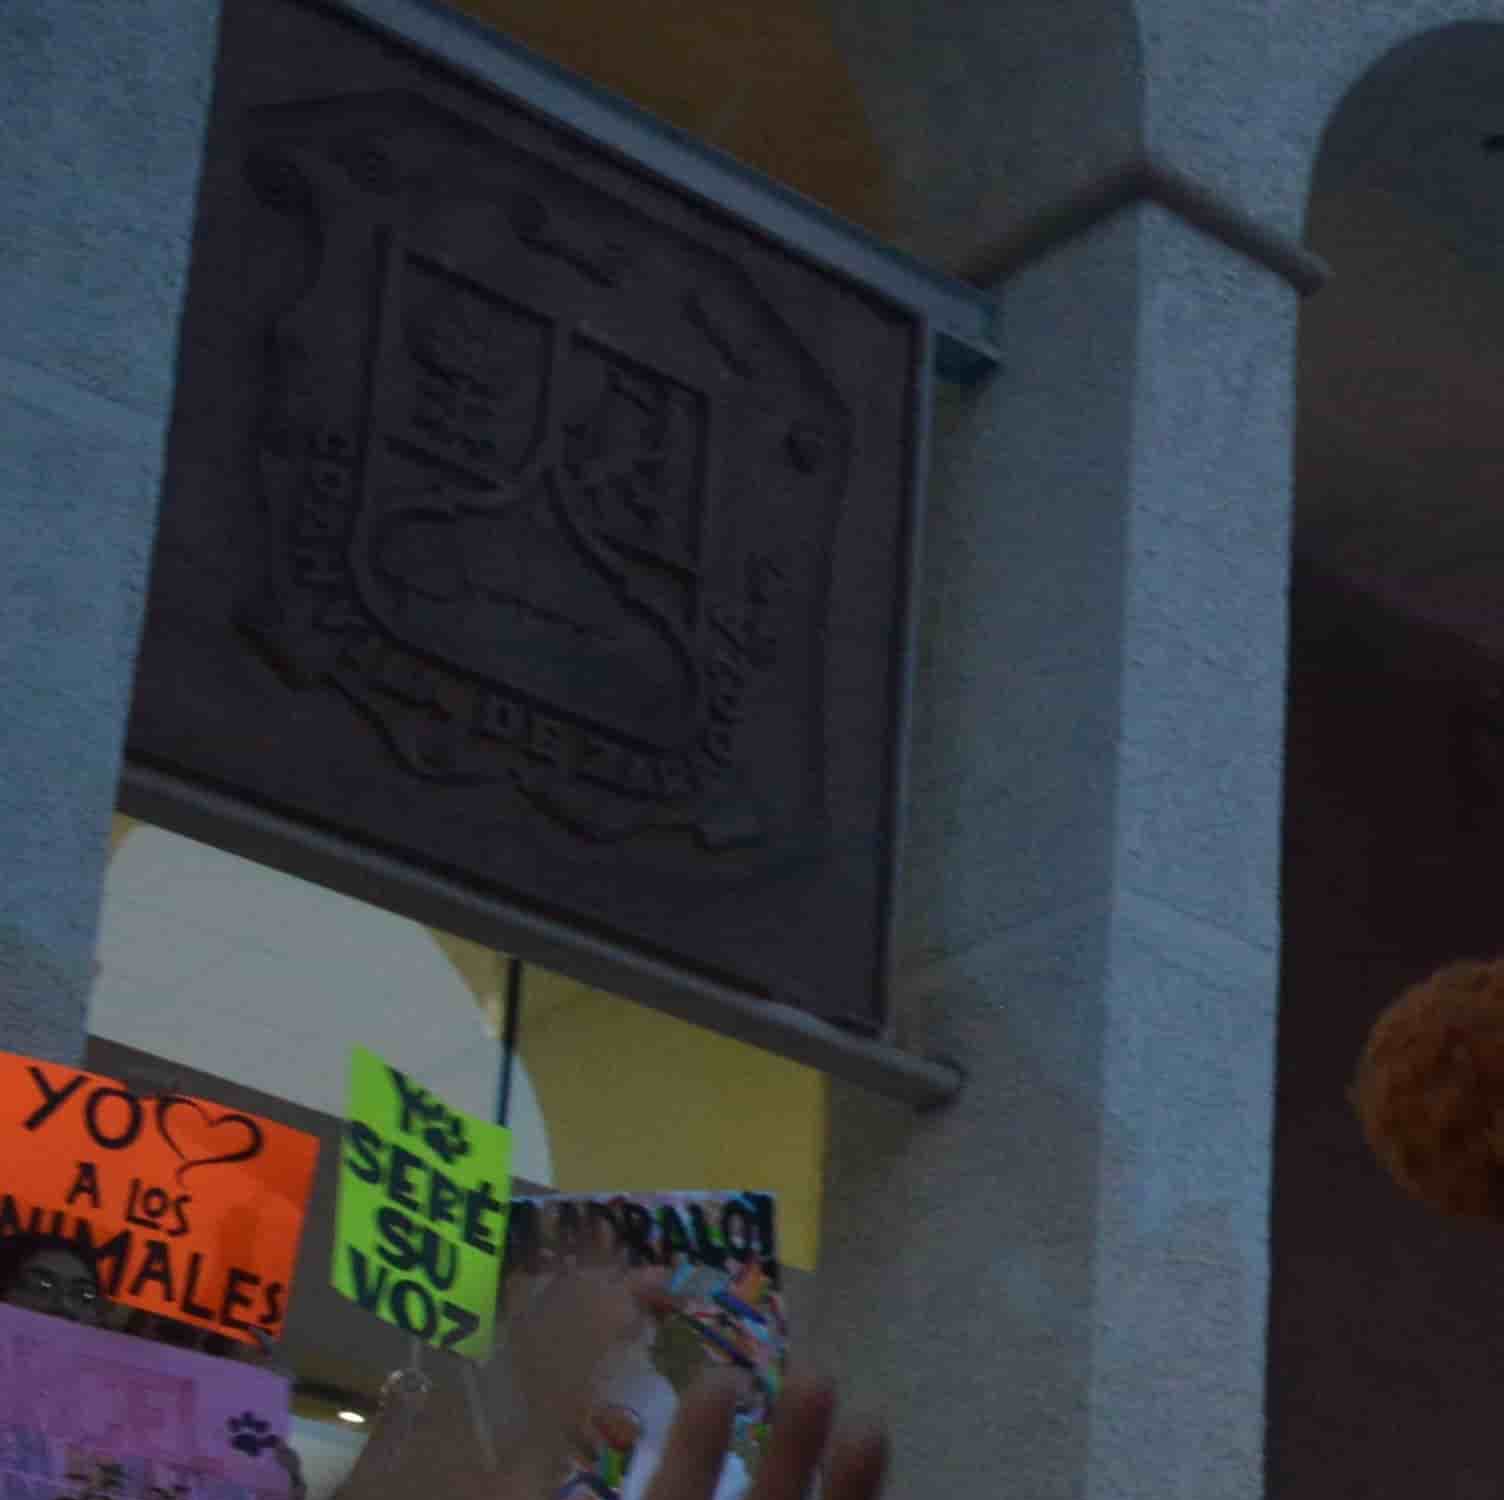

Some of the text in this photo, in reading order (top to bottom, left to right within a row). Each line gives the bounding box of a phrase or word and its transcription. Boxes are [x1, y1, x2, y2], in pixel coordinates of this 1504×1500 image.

[23, 1066, 143, 1150] YO
[66, 1161, 101, 1208] A
[125, 1178, 192, 1237] LOS
[377, 1207, 457, 1292] SU
[350, 1246, 480, 1360] VOZ
